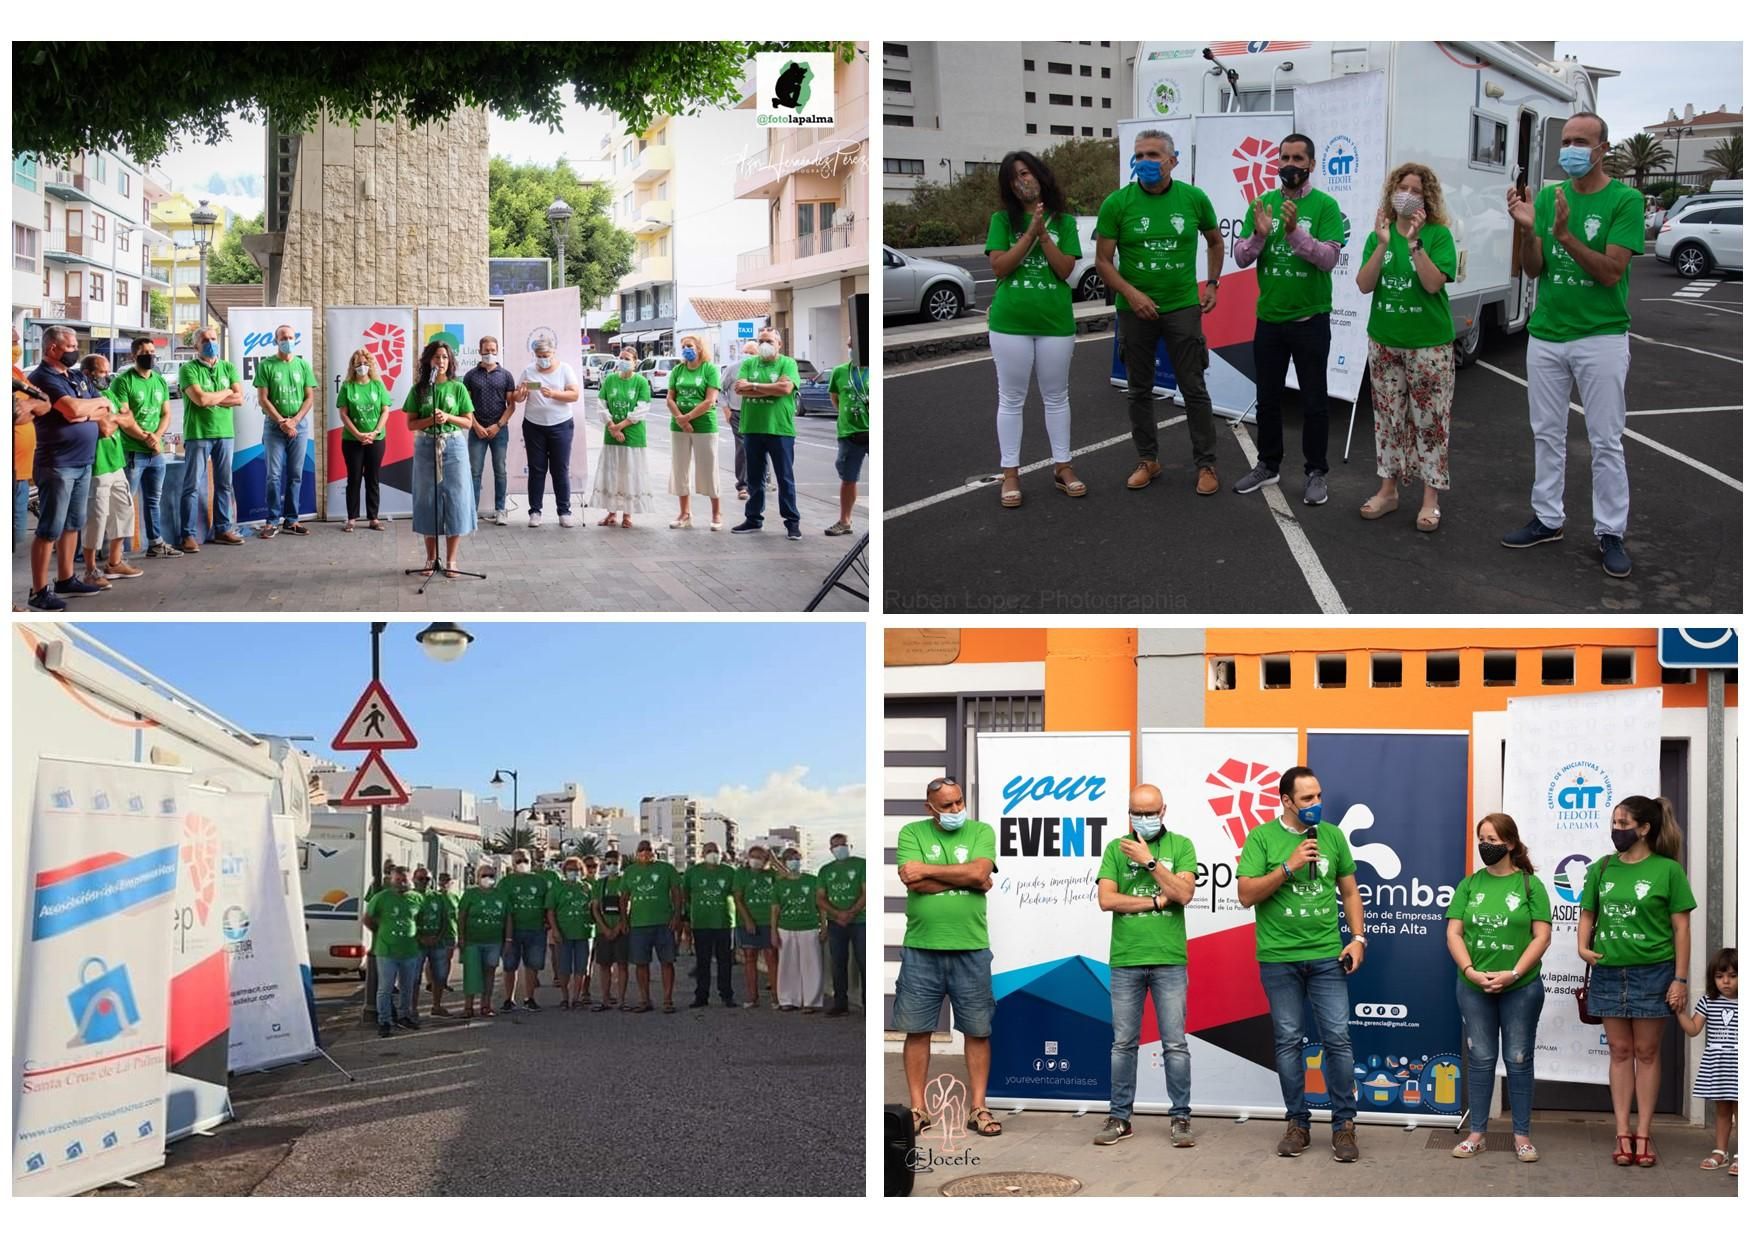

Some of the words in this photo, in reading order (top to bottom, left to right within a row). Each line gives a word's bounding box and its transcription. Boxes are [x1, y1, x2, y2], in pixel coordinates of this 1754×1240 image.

[1003, 775, 1106, 815] your
[1558, 777, 1604, 809] CIT
[1559, 810, 1600, 820] TEDOTE
[1569, 821, 1599, 830] PALMA
[1000, 817, 1108, 857] EVENT
[1381, 911, 1393, 919] de
[1396, 911, 1442, 921] Empresas
[1400, 923, 1427, 935] Alta
